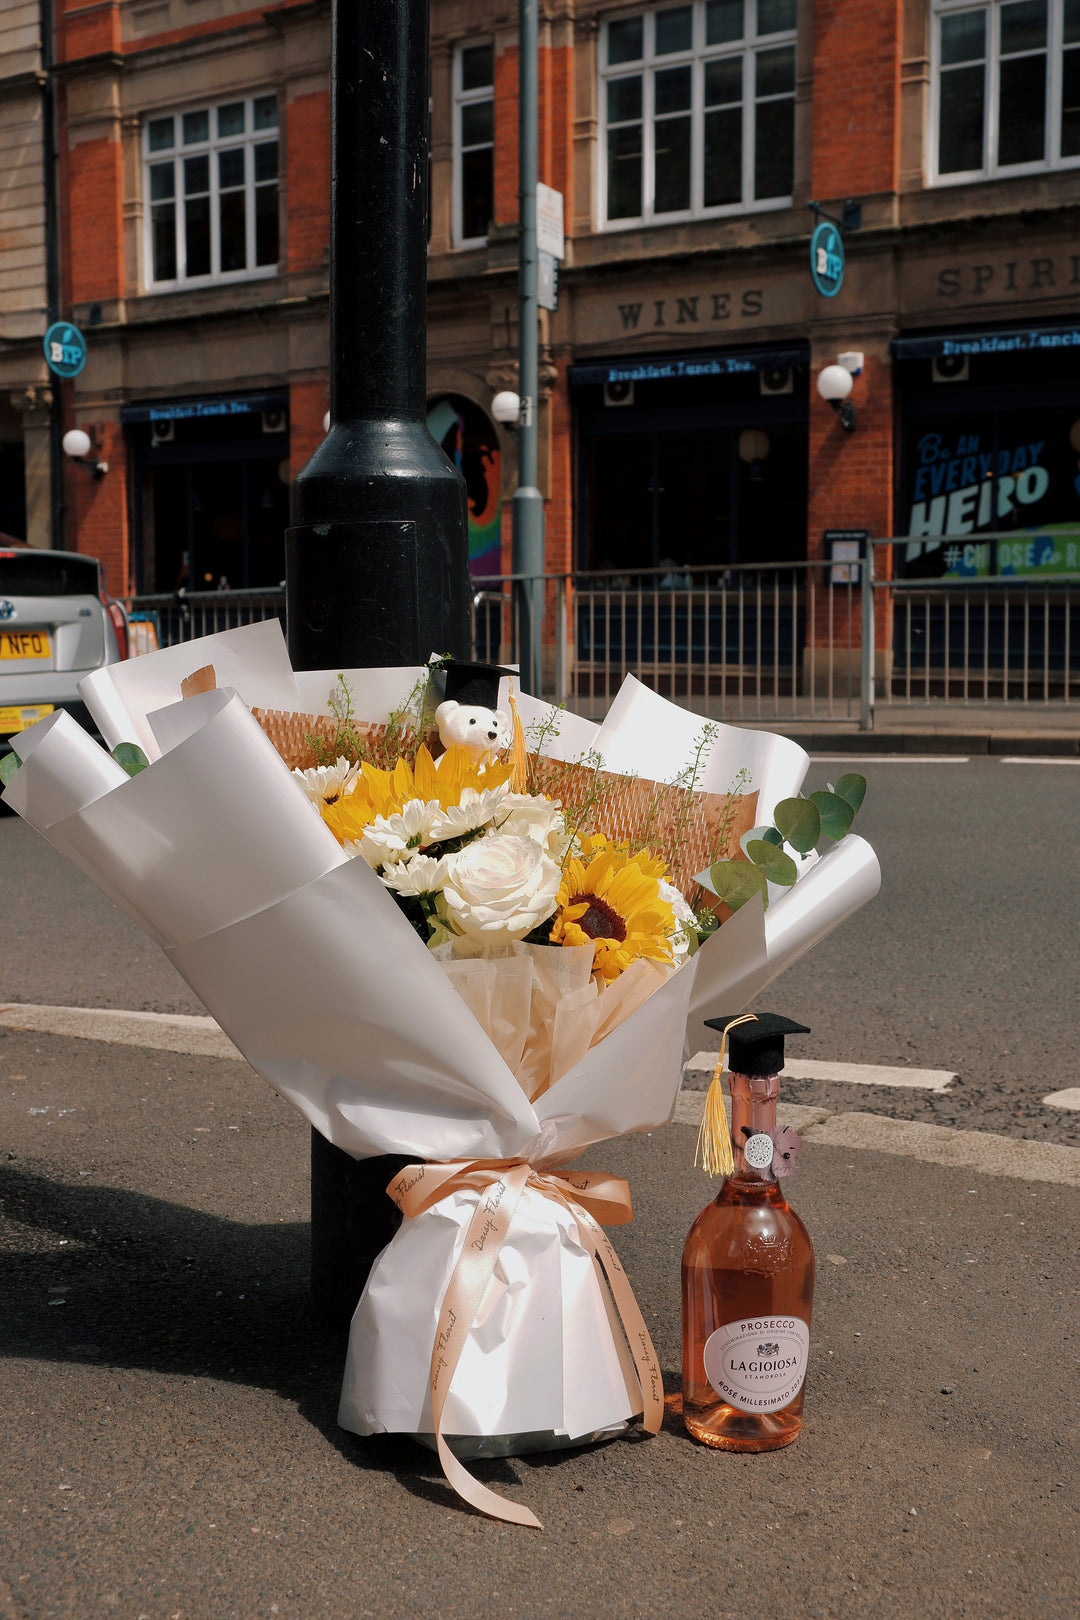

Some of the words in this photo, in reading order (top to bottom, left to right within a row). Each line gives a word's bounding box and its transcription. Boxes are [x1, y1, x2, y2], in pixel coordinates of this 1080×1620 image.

[816, 247, 843, 280] BTP
[617, 290, 764, 330] WINES
[50, 341, 83, 366] BTP
[917, 432, 951, 465] Be
[956, 433, 981, 457] AN
[913, 440, 1047, 501] EVERYDAY
[905, 465, 1050, 563] HERO
[943, 542, 1036, 570] #CHOSE
[1040, 545, 1062, 566] to
[7, 634, 43, 655] NFO
[394, 1165, 426, 1197] Florist
[483, 1177, 507, 1215] Florist
[471, 1218, 498, 1251] Daisy
[437, 1308, 457, 1351] Florist
[740, 1320, 795, 1332] PROSECCO
[432, 1355, 448, 1391] Daisy
[638, 1330, 651, 1364] Daisy
[649, 1363, 660, 1402] Florist
[718, 1380, 738, 1399] ROSÉ
[740, 1391, 790, 1406] MILLESIMATO
